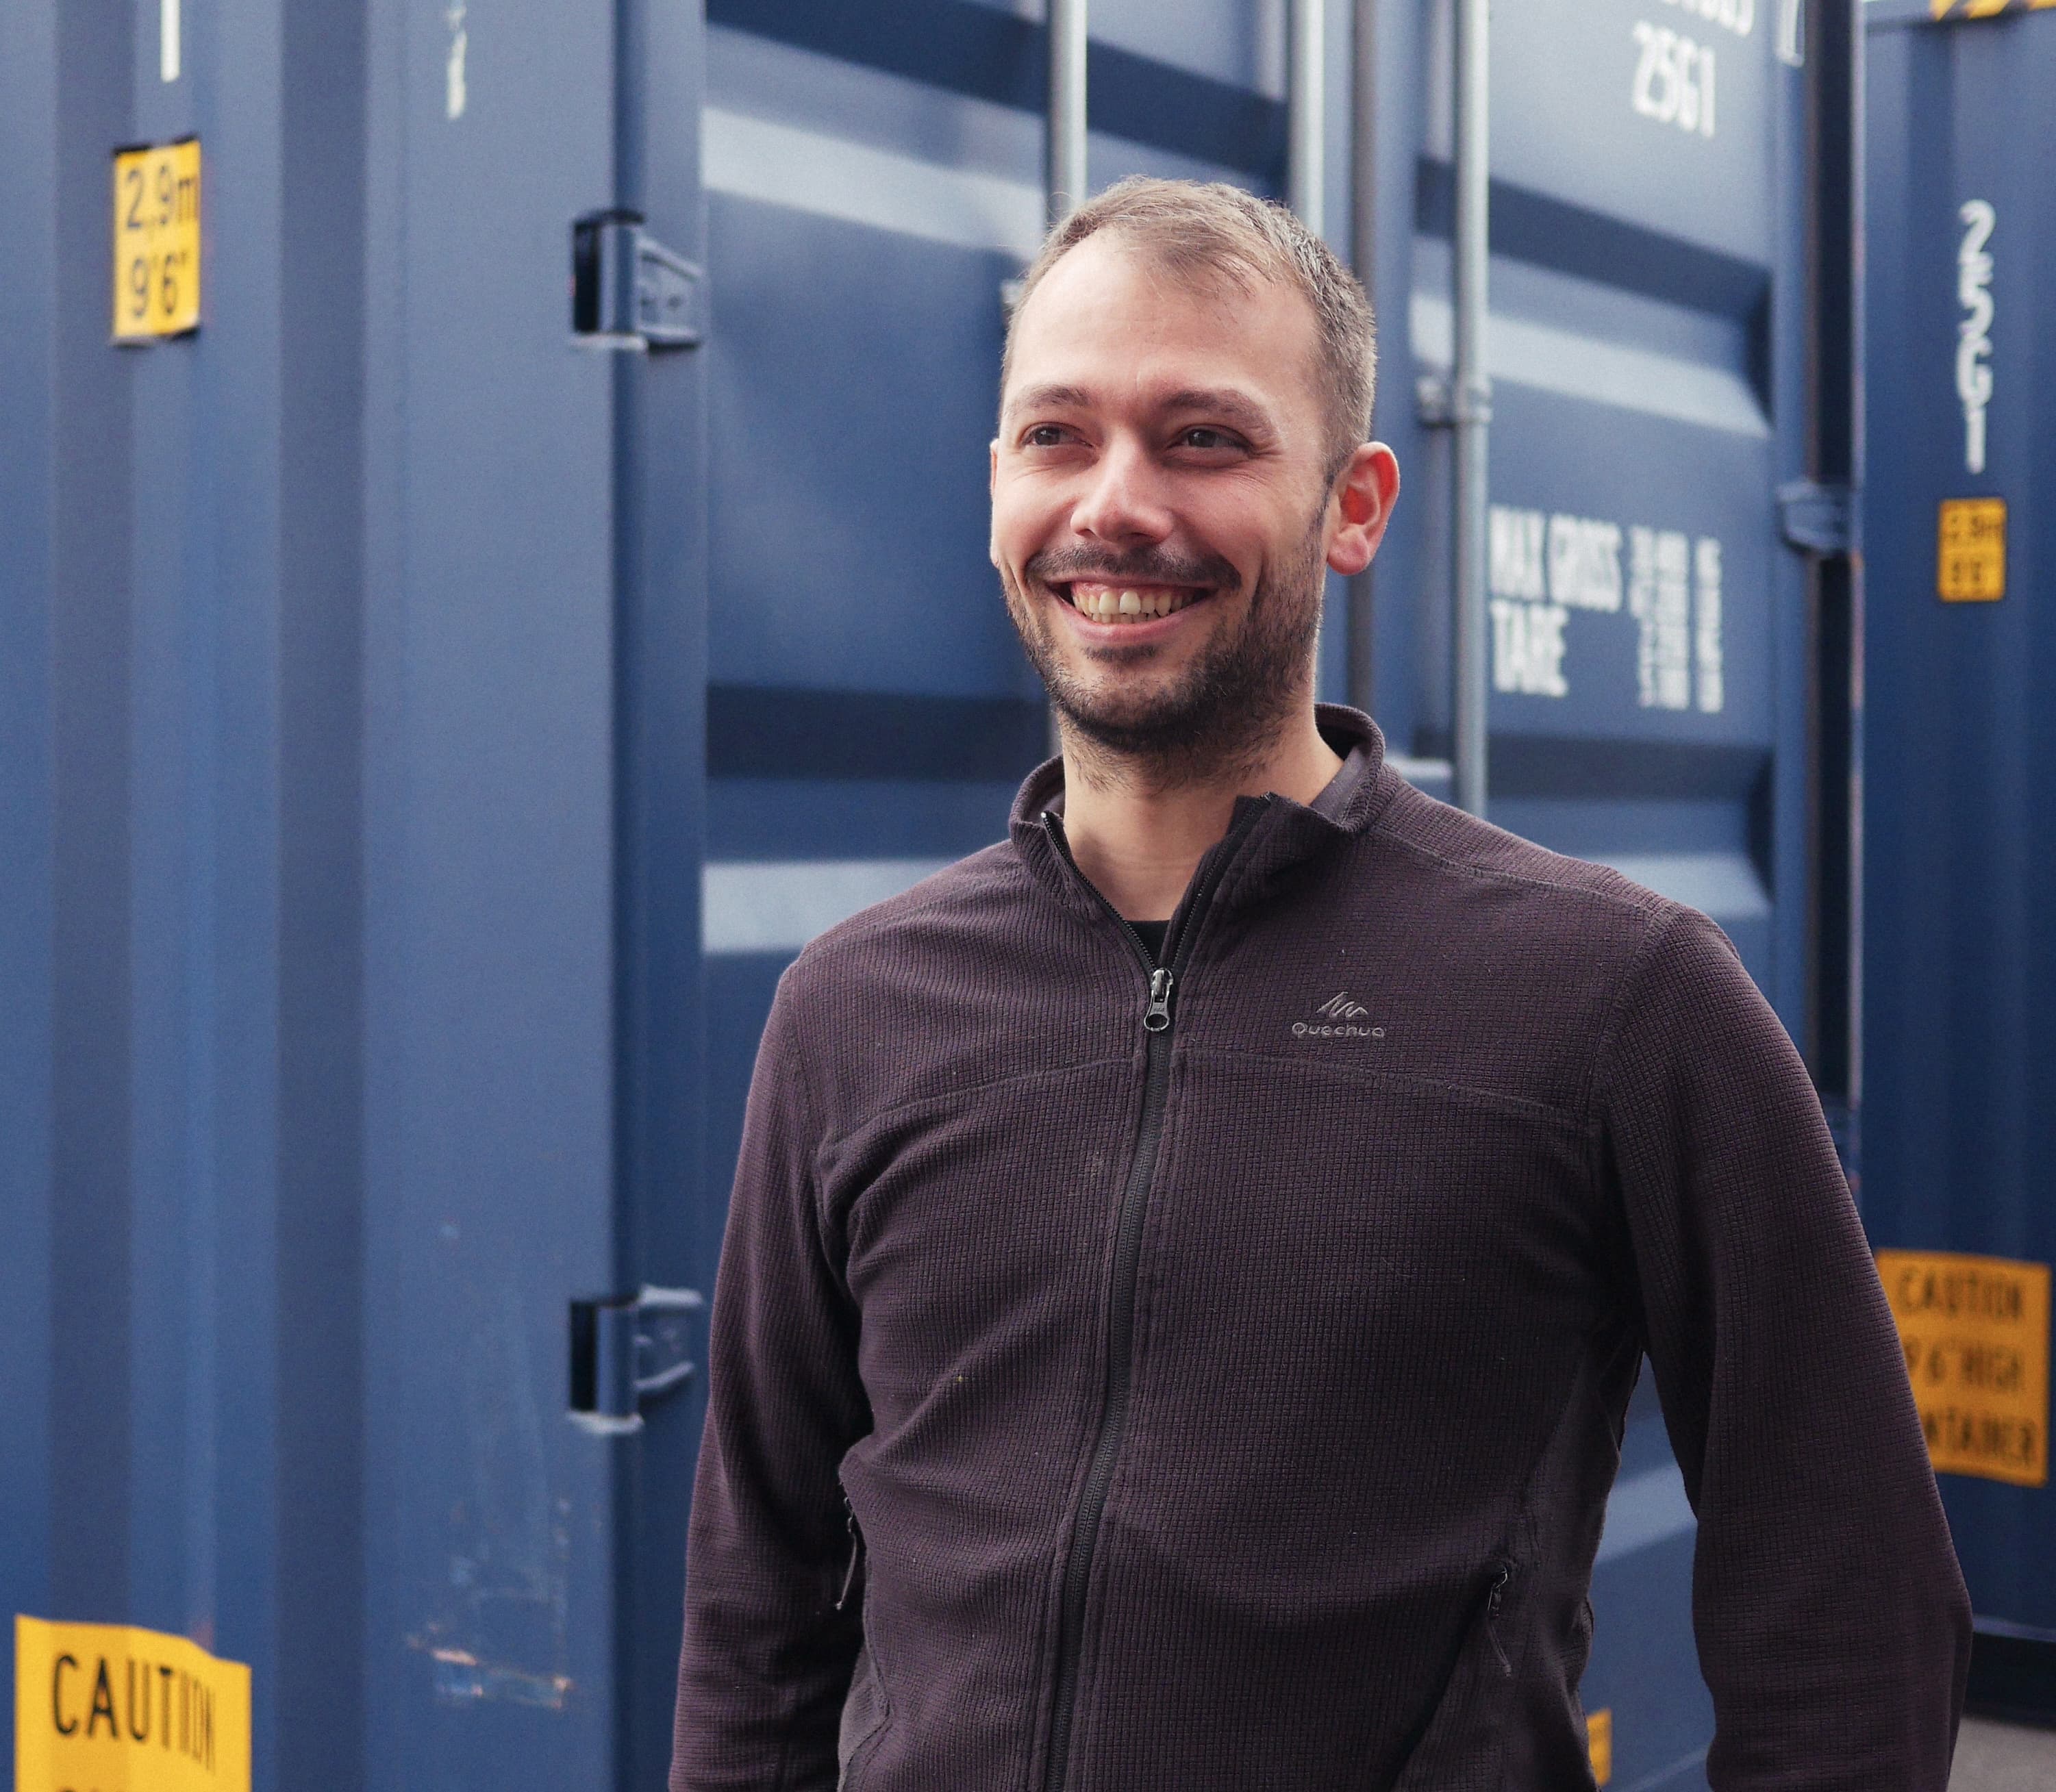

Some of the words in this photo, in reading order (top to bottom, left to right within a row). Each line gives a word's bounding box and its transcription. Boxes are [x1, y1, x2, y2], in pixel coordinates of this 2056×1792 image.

[1956, 199, 1996, 474] 25G1
[1291, 1022, 1386, 1039] Quechua
[51, 1652, 216, 1775] CAUTION
